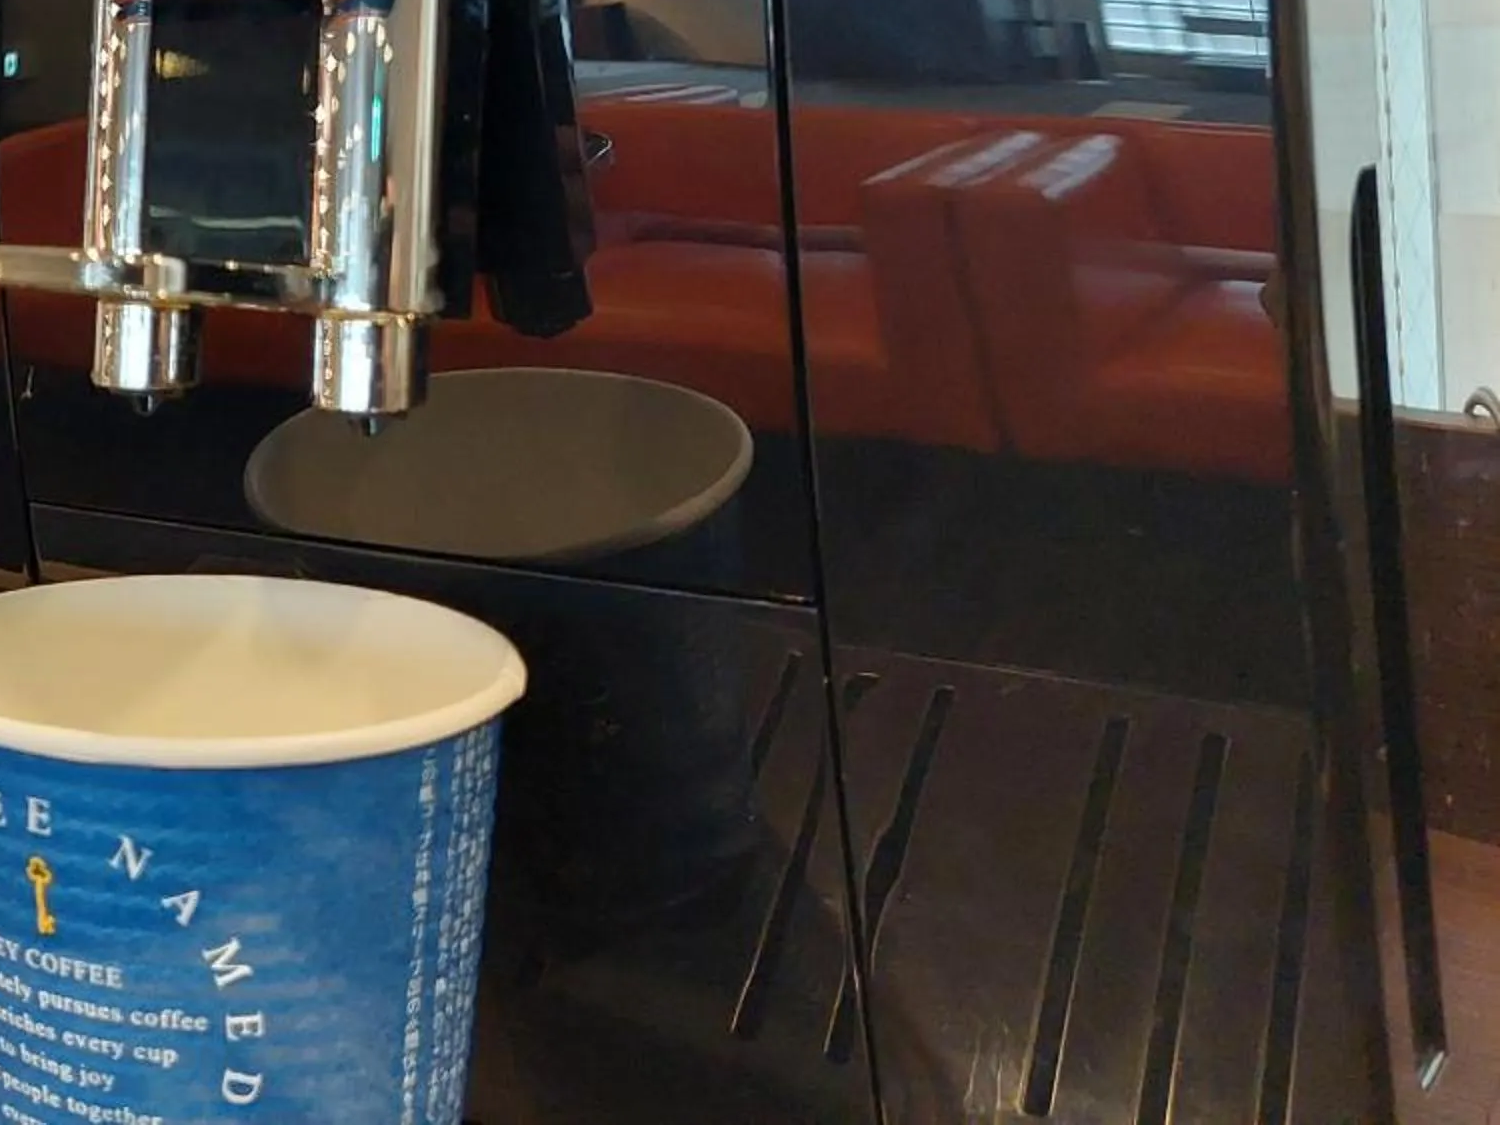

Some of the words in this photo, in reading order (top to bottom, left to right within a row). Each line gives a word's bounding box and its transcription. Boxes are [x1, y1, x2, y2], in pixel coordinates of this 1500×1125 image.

[24, 948, 123, 989] COFFEE
[38, 990, 123, 1023] pursues
[130, 1008, 209, 1032] coffee
[20, 1042, 73, 1084] bring
[78, 1063, 115, 1092] joy
[62, 1030, 124, 1061] every
[133, 1044, 179, 1068] cup
[2, 1071, 61, 1108] people
